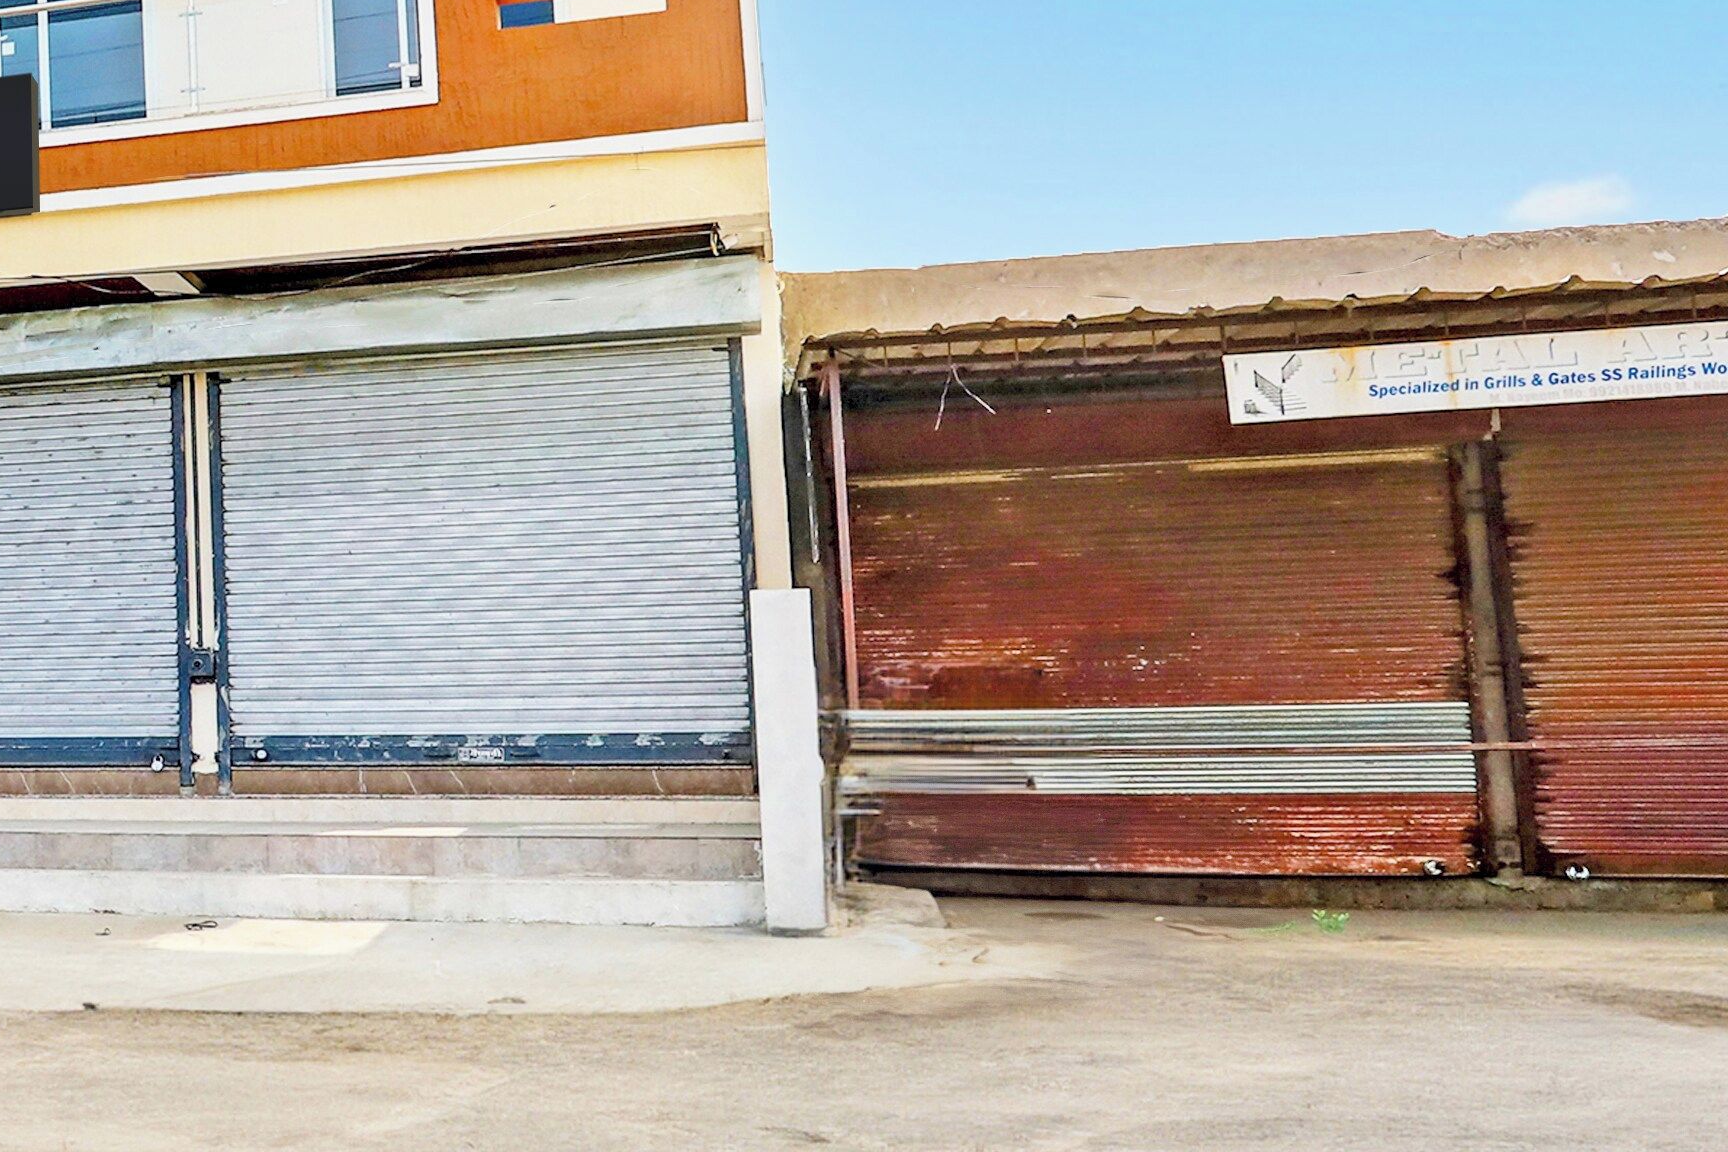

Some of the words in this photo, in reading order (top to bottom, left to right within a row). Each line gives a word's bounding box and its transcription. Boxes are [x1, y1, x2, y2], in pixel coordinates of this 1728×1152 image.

[1605, 325, 1728, 363] AR
[1368, 379, 1460, 399] Specialized
[1464, 377, 1479, 390] in
[1483, 374, 1527, 390] Grills
[1530, 372, 1543, 387] &
[1547, 371, 1596, 386] Gates
[1600, 367, 1623, 382] SS
[1627, 362, 1697, 380] Railings
[1700, 360, 1728, 375] Wo
